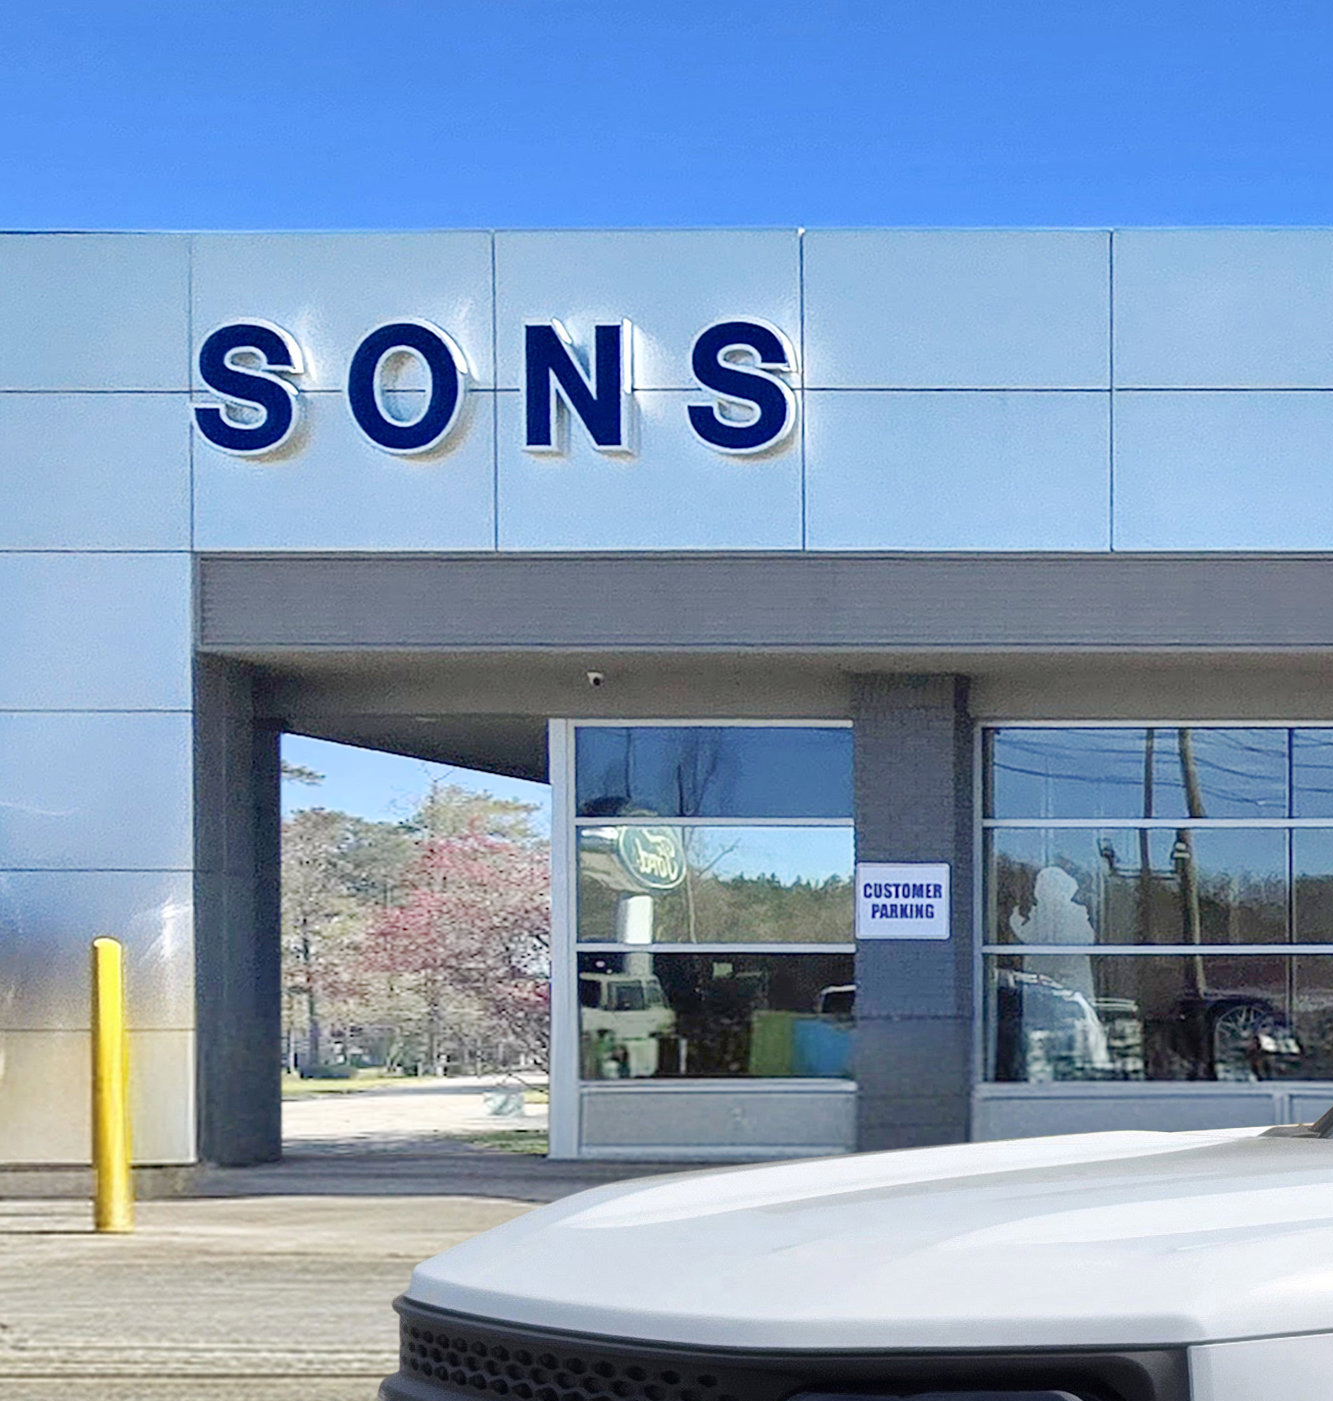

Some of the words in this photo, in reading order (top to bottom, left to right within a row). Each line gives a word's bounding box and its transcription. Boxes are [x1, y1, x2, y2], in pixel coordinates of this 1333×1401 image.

[191, 320, 798, 453] SONS
[863, 882, 943, 899] CUSTOMER
[871, 903, 935, 919] PARKING
